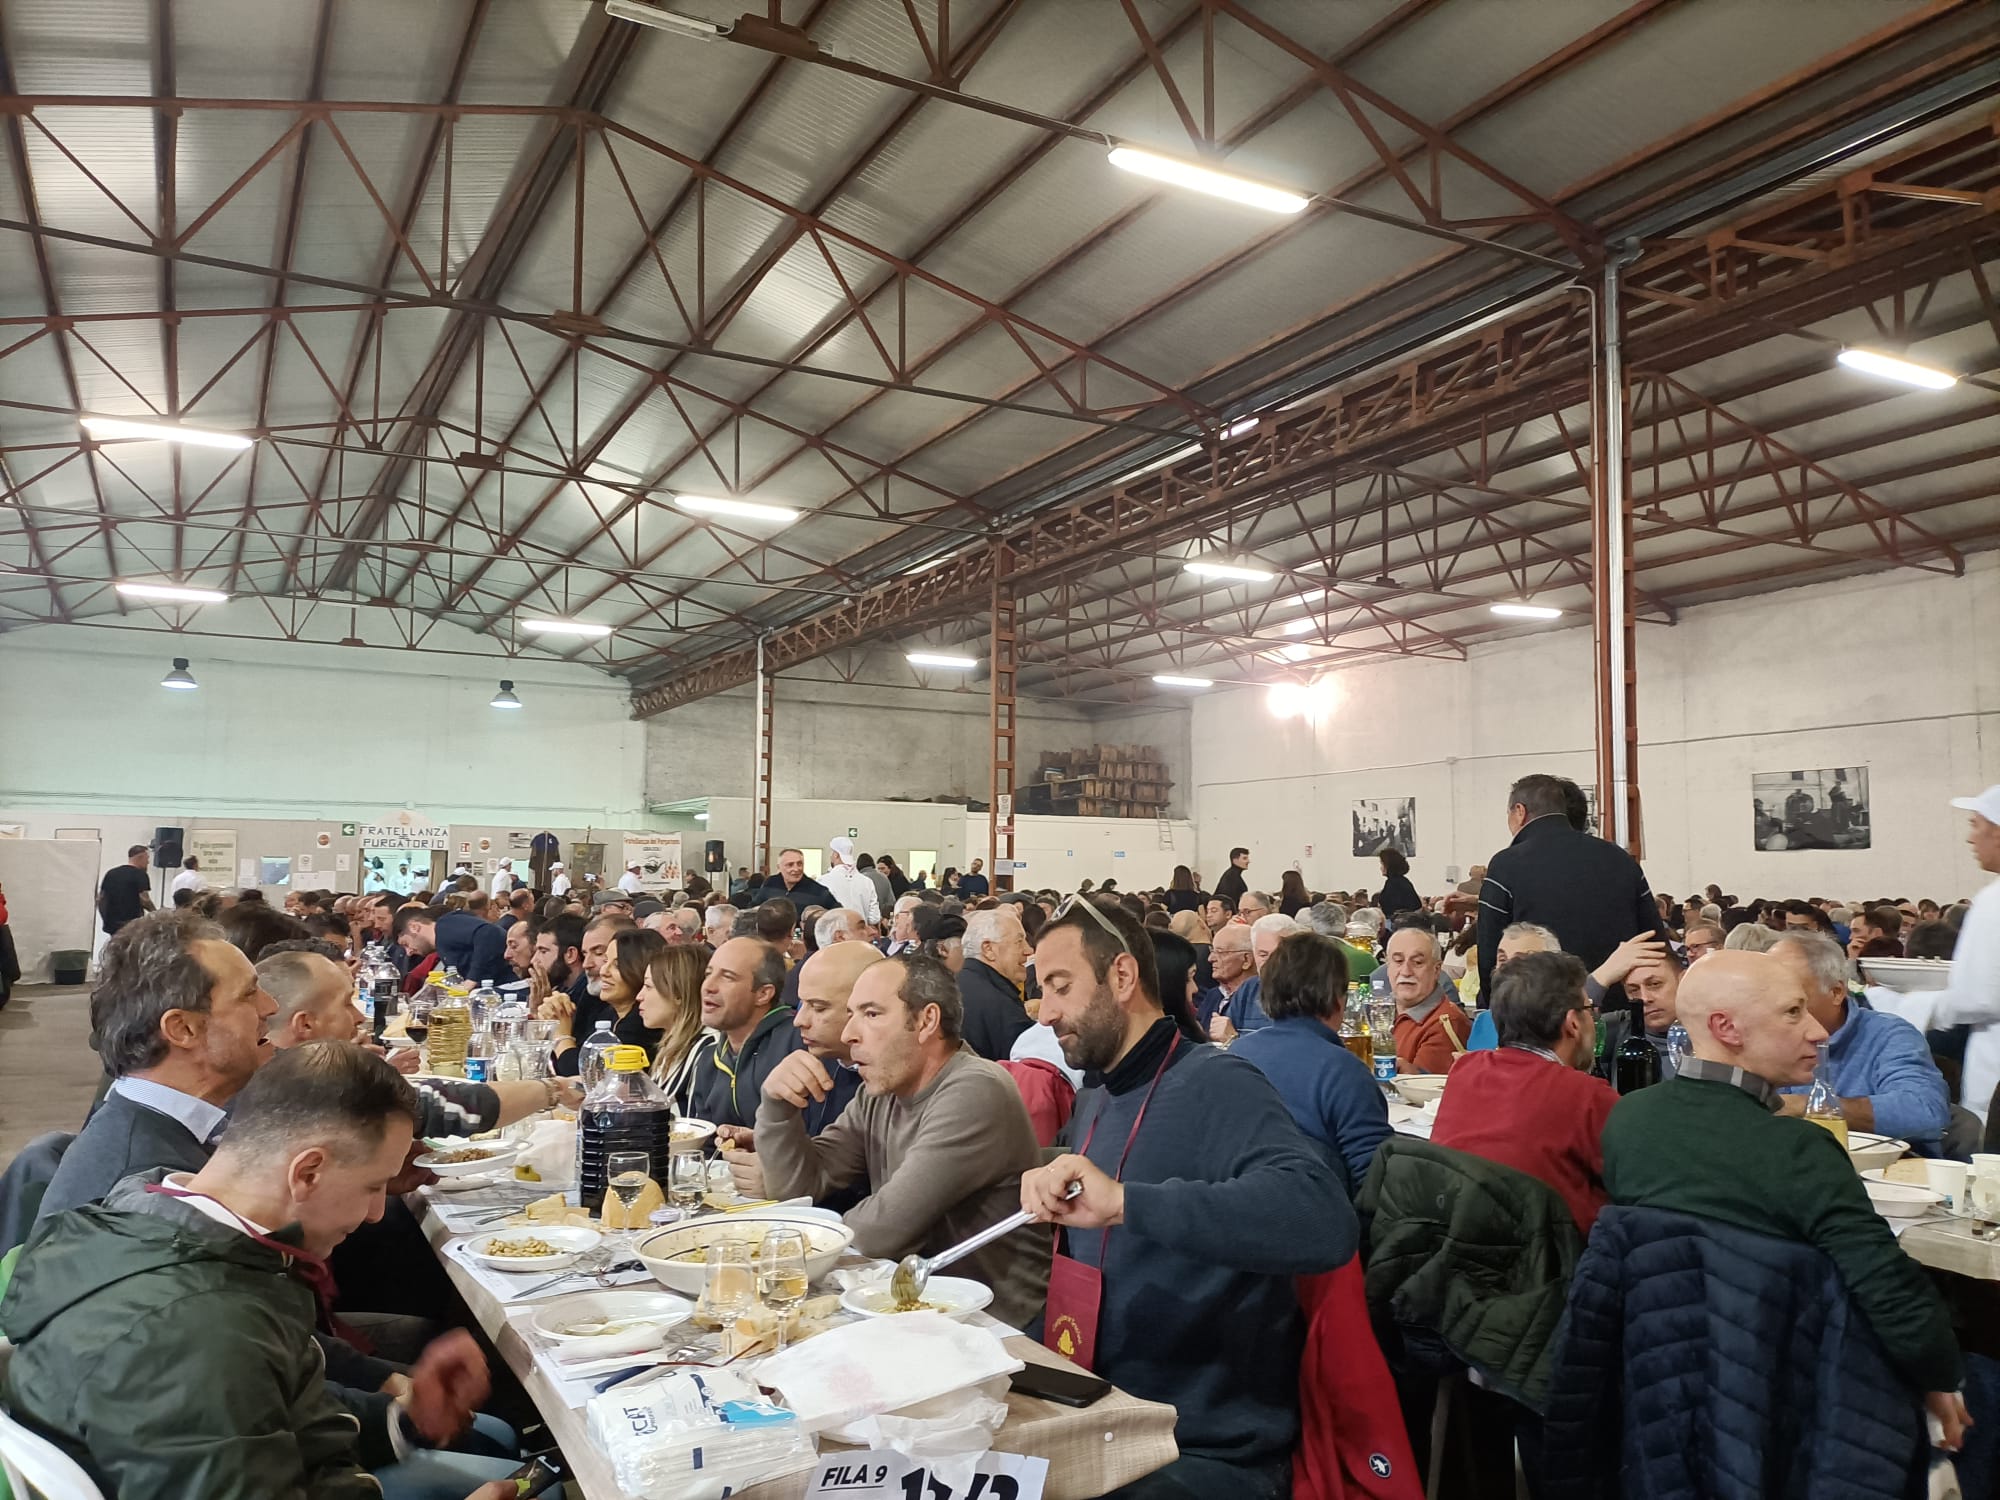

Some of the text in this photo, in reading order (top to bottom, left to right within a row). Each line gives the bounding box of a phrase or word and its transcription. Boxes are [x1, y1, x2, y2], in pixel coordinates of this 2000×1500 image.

[360, 825, 448, 836] FRATELLANZA
[363, 838, 445, 849] PURGATORIO
[821, 1463, 888, 1487] FILA 9
